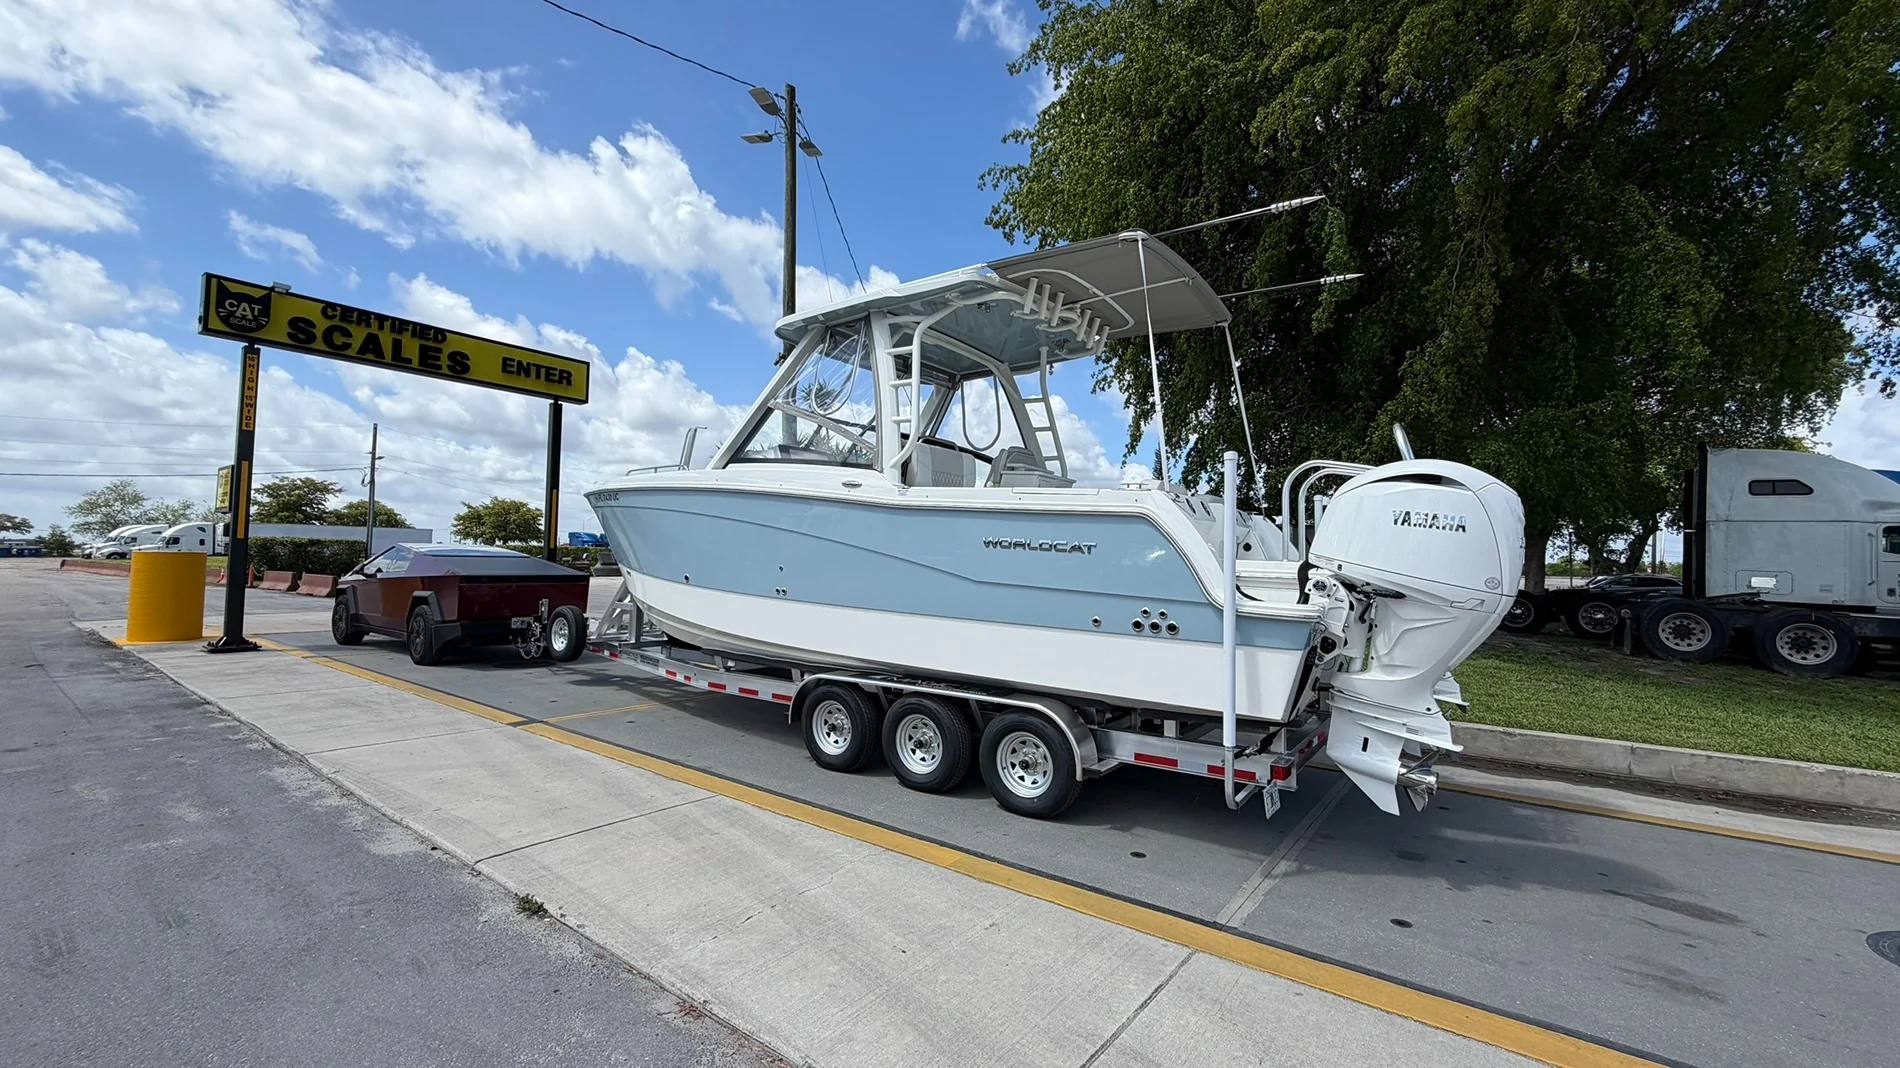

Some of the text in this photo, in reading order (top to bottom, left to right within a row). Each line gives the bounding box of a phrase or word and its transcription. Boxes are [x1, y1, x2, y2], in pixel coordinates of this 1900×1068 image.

[225, 299, 262, 319] CAT
[229, 317, 257, 328] SCALE
[320, 303, 448, 344] CERTIFIED
[286, 316, 471, 375] SCALES
[246, 362, 256, 391] HIGH
[501, 356, 573, 386] ENTER
[244, 402, 254, 428] WIDE
[1391, 510, 1467, 533] YAMAHA
[982, 536, 1098, 555] WORLDCAT
